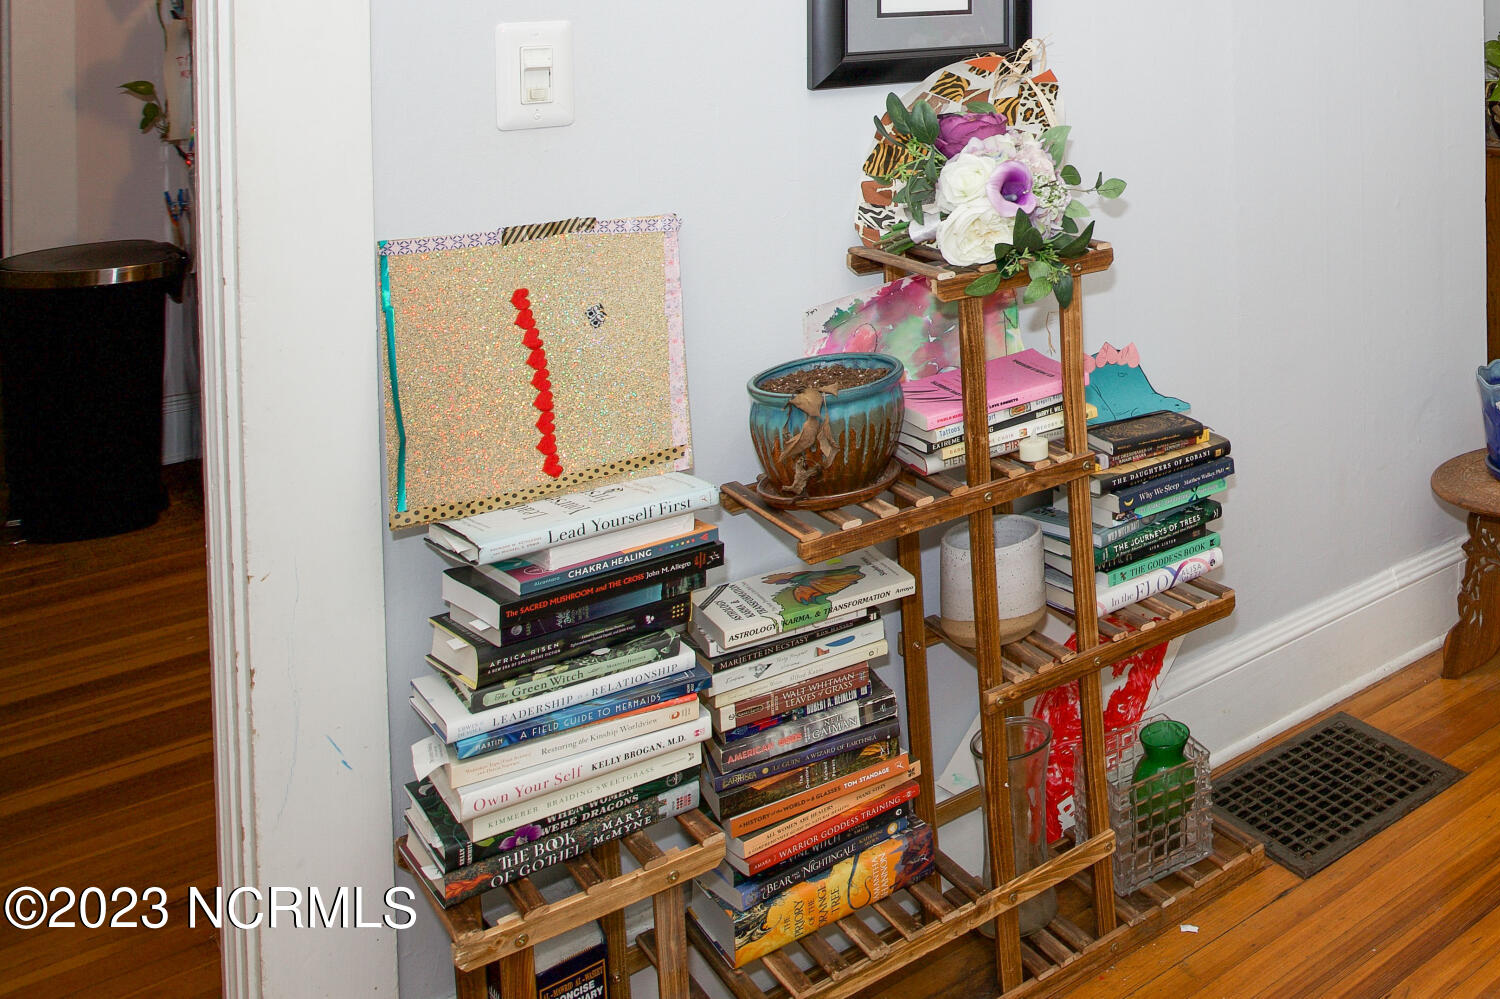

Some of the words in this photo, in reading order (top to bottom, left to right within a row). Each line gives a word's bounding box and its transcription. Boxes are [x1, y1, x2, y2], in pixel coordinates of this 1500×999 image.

[932, 436, 961, 451] EXTREME
[938, 425, 961, 438] Tattoos
[1112, 476, 1128, 487] THE
[1130, 462, 1172, 482] DAUGHTERS
[1174, 459, 1183, 467] OF
[1185, 450, 1211, 464] KOBANI
[1138, 491, 1154, 503] Why
[1154, 488, 1164, 498] We
[1164, 482, 1180, 497] Sleep
[1183, 476, 1201, 486] Matthew
[548, 523, 586, 545] Lead
[592, 502, 657, 532] Yourself
[658, 498, 692, 516] First
[1113, 543, 1129, 553] THE
[1131, 528, 1168, 546] JOURNEYS
[1168, 523, 1178, 532] OF
[1179, 514, 1201, 528] TREES
[567, 560, 610, 580] CHAKRA
[611, 549, 653, 569] HEALING
[1129, 565, 1147, 577] THE
[1147, 552, 1183, 571] GODDESS
[1184, 543, 1205, 558] BOOK
[505, 608, 519, 619] The
[520, 600, 549, 616] SACRED
[549, 587, 594, 608] MUSHROOM
[594, 582, 608, 594] and
[608, 579, 623, 591] THE
[623, 572, 645, 587] CROSS
[645, 569, 660, 581] John
[670, 560, 692, 574] Allegro
[1111, 597, 1122, 608] In
[1122, 591, 1134, 604] the
[1135, 574, 1169, 601] FLO
[728, 622, 777, 642] ASTROLOGY
[814, 609, 822, 618] &
[823, 590, 892, 616] TRANSFORMATION
[895, 584, 914, 595] Arroyo
[488, 650, 528, 668] AFRICA
[530, 641, 561, 658] RISEN
[719, 649, 764, 671] MARIETTE
[765, 646, 776, 656] IN
[775, 635, 810, 652] ECSTASY
[492, 694, 574, 727] LEADERSHIP
[591, 663, 679, 697] RELATIONSHIP
[511, 678, 547, 698] Green
[550, 669, 585, 688] Witch
[782, 686, 806, 699] WALT
[808, 671, 856, 692] WHITMAN
[785, 692, 816, 709] LEAVES
[825, 680, 854, 695] GRASS
[475, 738, 504, 751] MARTIN
[520, 730, 528, 741] A
[531, 721, 560, 737] FIELD
[563, 712, 595, 728] GUIDE
[597, 707, 611, 718] TO
[615, 692, 662, 716] MERMAIDS
[541, 740, 577, 756] Restoring
[578, 736, 590, 746] the
[590, 726, 619, 743] Kinship
[619, 717, 658, 734] Worldview
[812, 717, 858, 740] GAIMAN
[823, 714, 844, 727] NEIL
[722, 770, 757, 789] EARTHSEA
[780, 757, 800, 769] GUIN
[810, 747, 836, 761] WIZARD
[837, 745, 846, 753] OF
[846, 733, 878, 750] EARTHSEA
[727, 740, 775, 765] AMERICAN
[778, 732, 803, 747] GODS
[473, 791, 510, 813] Own
[513, 779, 549, 801] Your
[553, 764, 585, 787] Self
[591, 754, 622, 771] KELLY
[623, 741, 666, 762] BROGAN,
[666, 735, 686, 747] M.D.
[487, 806, 539, 829] KIMMERER
[546, 788, 593, 810] BRAIDING
[594, 766, 656, 793] SWEETGRASS
[541, 816, 578, 836] WERE
[580, 794, 640, 822] DRAGONS
[546, 804, 585, 824] WHEN
[587, 787, 635, 810] WOMEN
[742, 813, 770, 827] HISTORY
[783, 800, 806, 813] WORLD
[814, 785, 841, 800] GLASSES
[843, 779, 858, 789] TOM
[858, 767, 891, 782] STANDAGE
[593, 816, 652, 846] McMYNE
[600, 808, 645, 832] MARY
[754, 858, 772, 870] AMARA
[779, 834, 819, 860] WARRIOR
[820, 815, 860, 839] GODDESS
[860, 795, 901, 820] TRAINING
[766, 832, 776, 840] ALL
[776, 823, 798, 835] WOMEN
[799, 816, 810, 824] ARE
[809, 804, 834, 819] HEALERS
[498, 852, 530, 872] THE
[536, 833, 576, 857] BOOK
[811, 834, 841, 855] WITCH
[490, 872, 516, 890] OF
[518, 846, 585, 878] GOTHEL
[766, 876, 793, 894] BEAR
[801, 843, 857, 879] NIGHTINGALE
[830, 886, 840, 914] TREE
[783, 915, 791, 934] THE
[793, 899, 803, 939] PRIORY
[808, 916, 814, 927] OF
